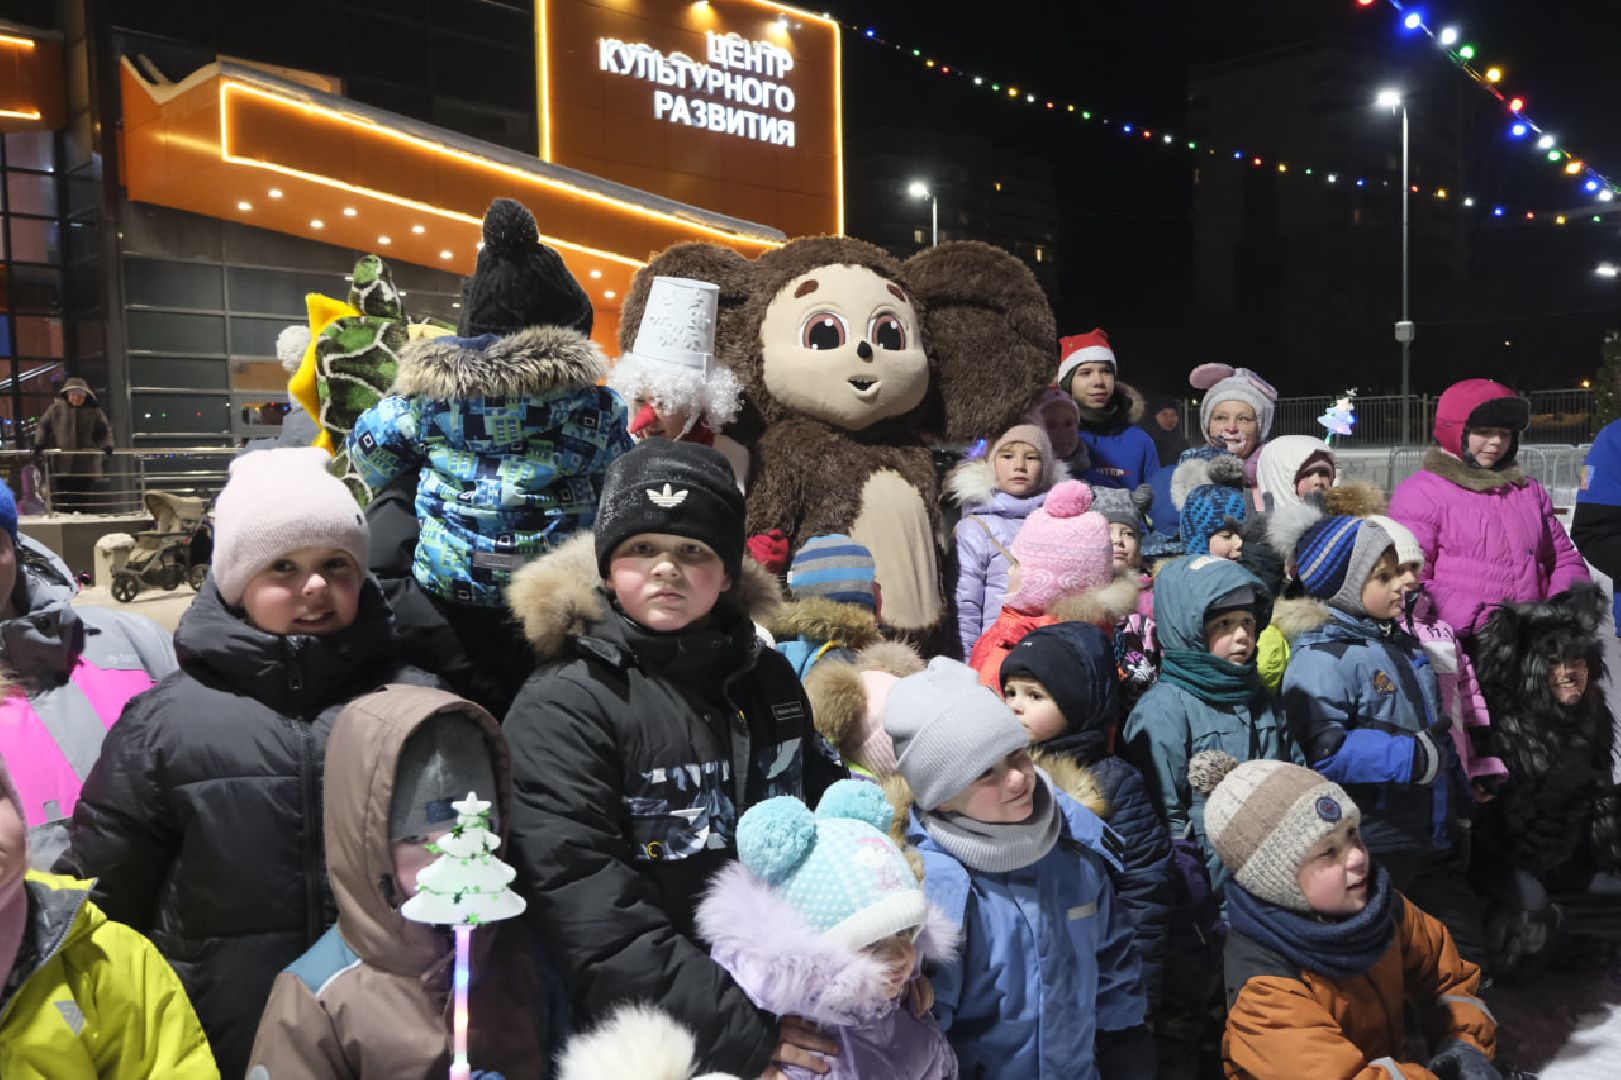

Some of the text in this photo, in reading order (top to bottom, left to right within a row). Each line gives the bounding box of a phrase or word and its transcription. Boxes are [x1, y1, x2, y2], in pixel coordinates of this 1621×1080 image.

[599, 38, 795, 112] КУЛЬТУРНОГО
[705, 31, 794, 78] ЦЕНТР
[654, 90, 795, 147] РАЗВИТИЯ
